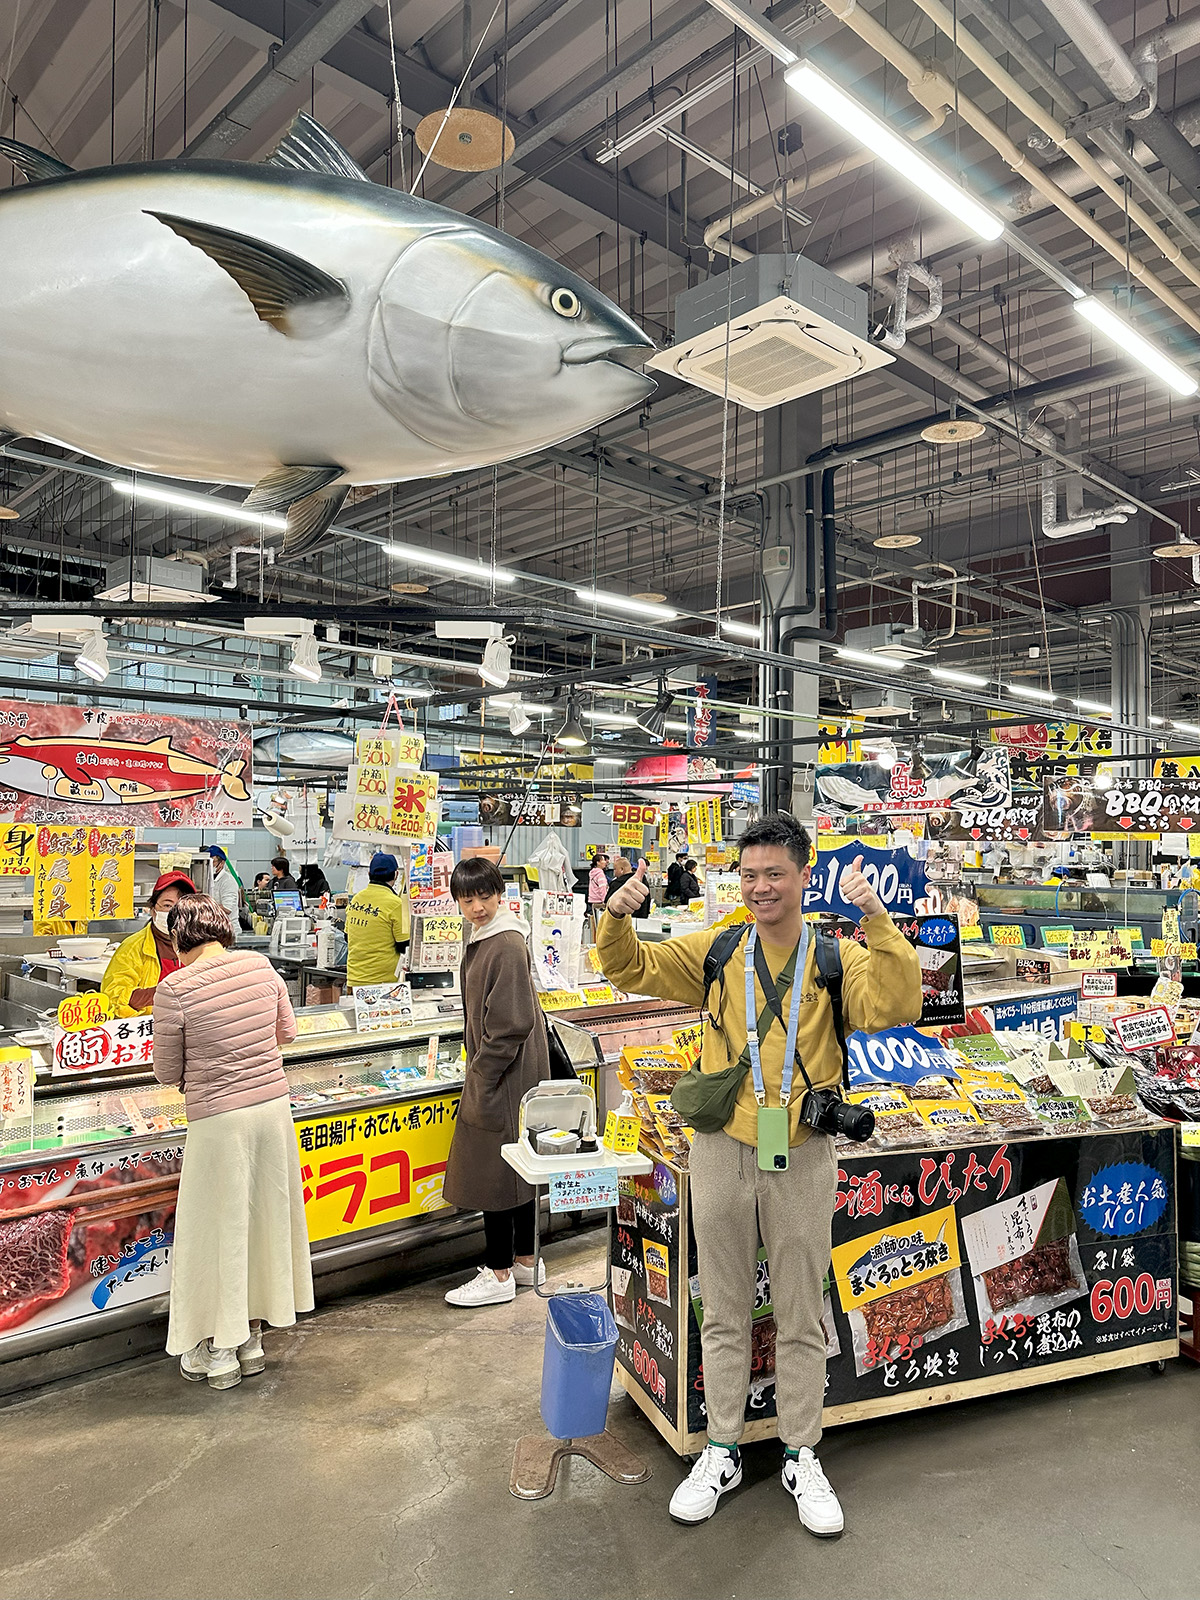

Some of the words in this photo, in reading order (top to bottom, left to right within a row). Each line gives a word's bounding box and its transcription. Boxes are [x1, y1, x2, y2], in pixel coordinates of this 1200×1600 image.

[158, 807, 183, 822] 本皮
[393, 785, 425, 813] 氷
[396, 812, 420, 820] あります
[613, 805, 657, 825] BBQ
[1138, 815, 1170, 830] こちら
[4, 825, 34, 857] 身
[985, 827, 1013, 840] こちら
[350, 917, 369, 927] STAFF
[1121, 1016, 1164, 1033] 常温で安心して
[1122, 1023, 1171, 1042] お持ち帰り出来ます!
[60, 1031, 107, 1070] 鯨
[0, 1145, 185, 1195] ・おでん・煮付・ステーキなど
[1082, 1178, 1166, 1208] お土産人気
[90, 1228, 166, 1278] 使いどころ
[871, 1231, 924, 1261] 漁師の味
[106, 1248, 171, 1294] たくさん!
[851, 1246, 950, 1298] まぐろのとろ炊き
[1090, 1272, 1173, 1323] 600円
[862, 1334, 924, 1369] まぐろの
[978, 1330, 1084, 1368] じっくり煮込み
[634, 1340, 667, 1404] 600円
[882, 1349, 960, 1388] とろ炊き
